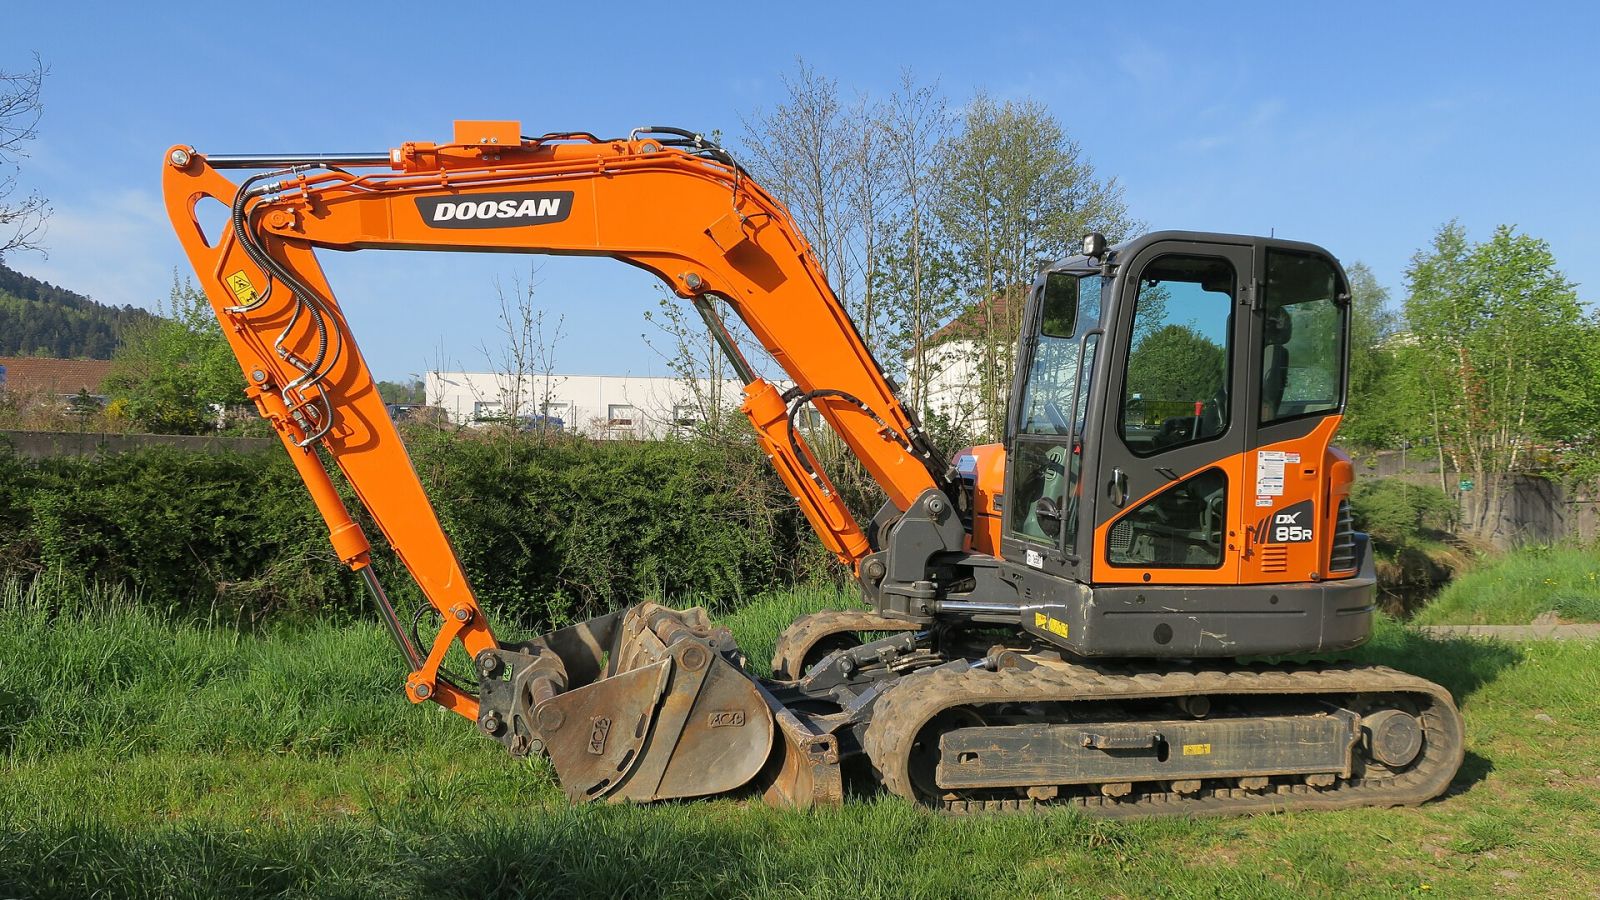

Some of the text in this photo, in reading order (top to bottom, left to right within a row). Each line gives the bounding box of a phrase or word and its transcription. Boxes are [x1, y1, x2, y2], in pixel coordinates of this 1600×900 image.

[433, 199, 560, 221] DOOSAN
[1275, 511, 1302, 524] DX
[1275, 526, 1312, 541] 85R
